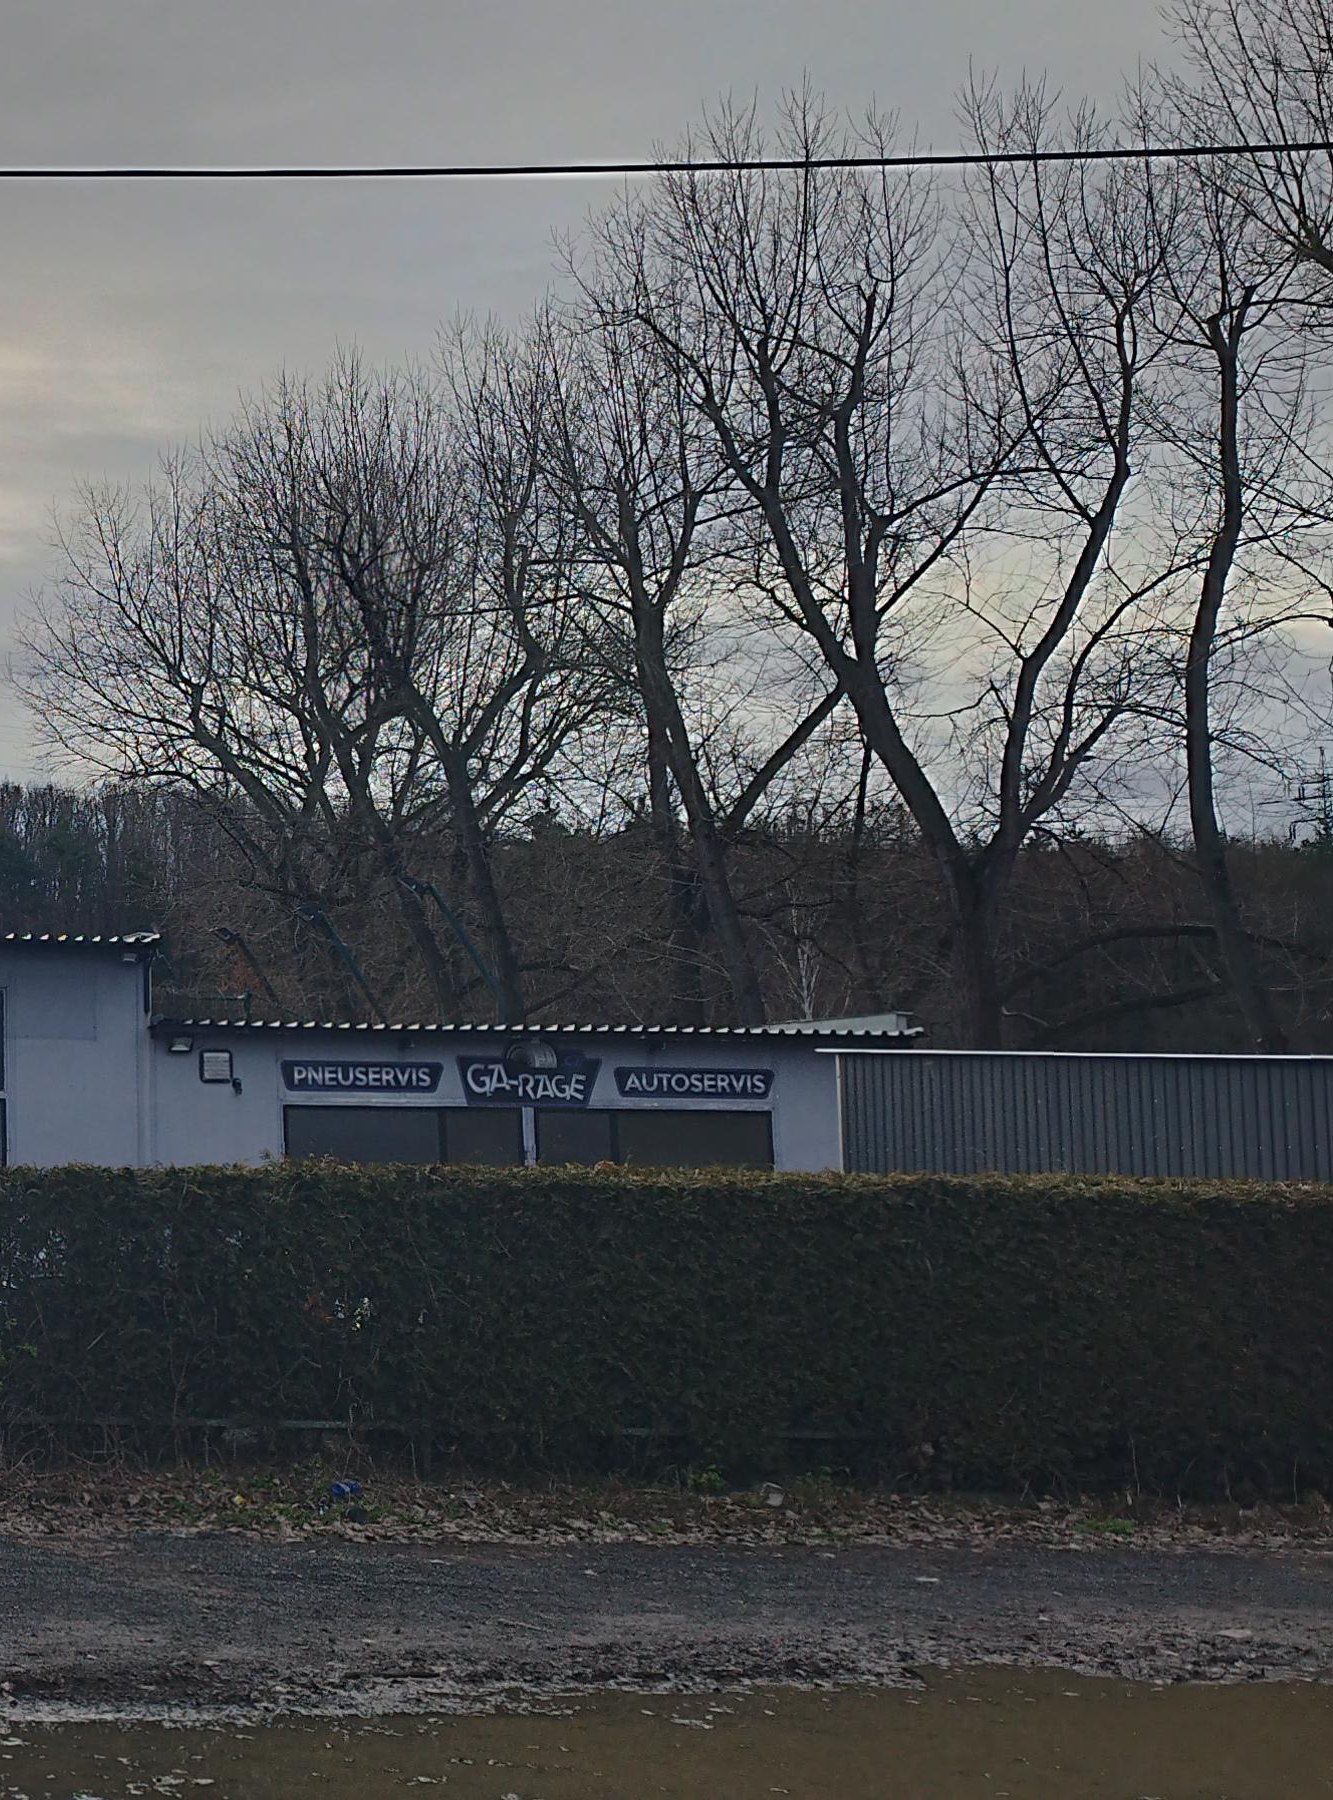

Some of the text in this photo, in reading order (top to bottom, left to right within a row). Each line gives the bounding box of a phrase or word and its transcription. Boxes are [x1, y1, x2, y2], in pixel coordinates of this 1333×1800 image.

[293, 1066, 431, 1087] PNEUSERVIS
[466, 1063, 587, 1101] GA-RAGE
[624, 1072, 766, 1094] AUTOSERVIS
